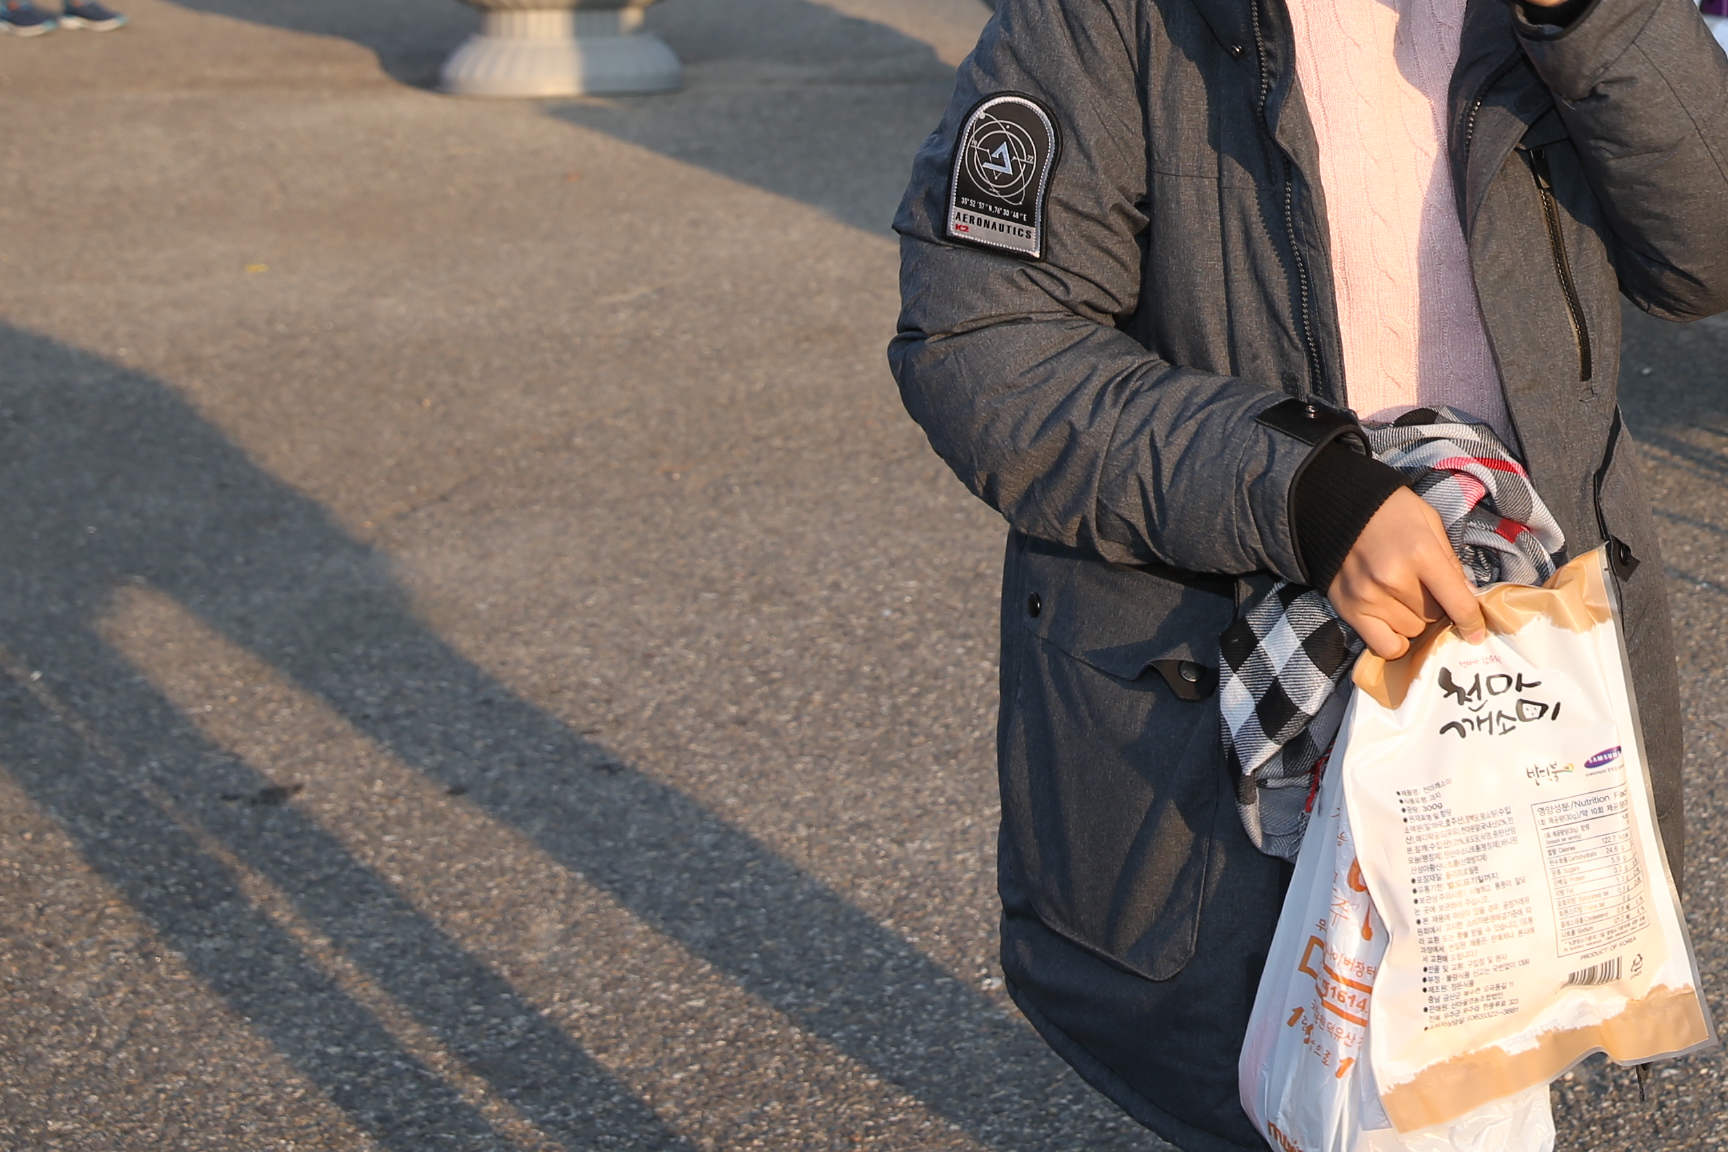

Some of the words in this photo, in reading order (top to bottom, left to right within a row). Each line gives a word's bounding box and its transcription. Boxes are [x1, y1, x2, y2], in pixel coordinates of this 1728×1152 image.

[955, 212, 1032, 240] AERONAUTICS
[955, 223, 969, 233] K2
[1438, 666, 1542, 712] 천마
[1439, 698, 1561, 739] 깨소미
[1422, 802, 1443, 812] 300g
[1580, 947, 1608, 960] PRODUCT
[1609, 944, 1619, 952] OF
[1620, 936, 1637, 947] KOREA
